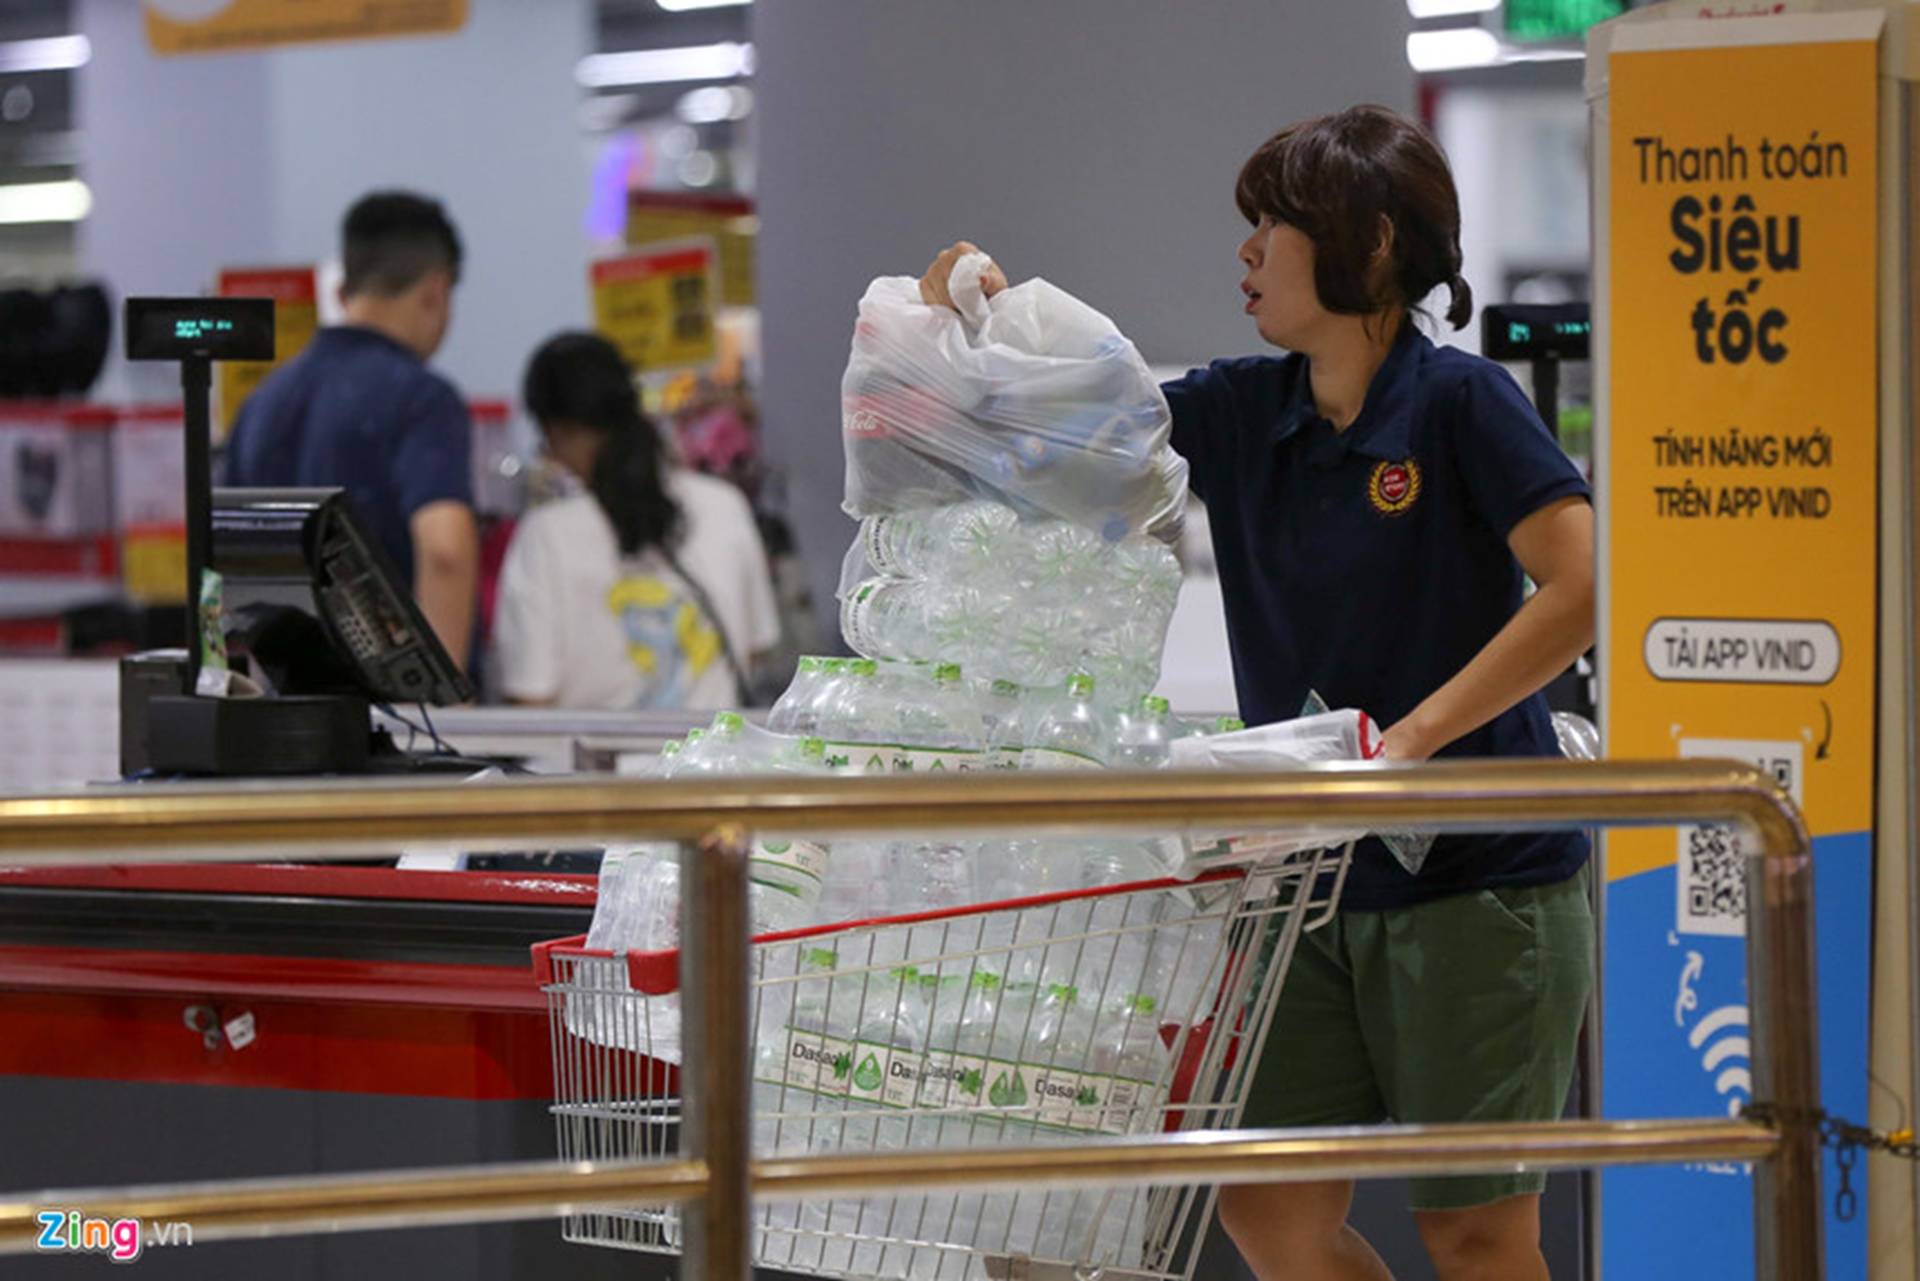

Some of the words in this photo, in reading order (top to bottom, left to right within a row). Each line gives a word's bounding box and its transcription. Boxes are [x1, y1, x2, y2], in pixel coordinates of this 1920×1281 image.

[1633, 134, 1748, 184] Thanh
[1759, 130, 1847, 179] toán
[1669, 194, 1800, 274] Siêu
[1691, 278, 1789, 364] tốc
[1652, 428, 1705, 467] TÍNH
[1708, 428, 1779, 468] NĂNG
[1783, 427, 1832, 468] MỚI
[1653, 478, 1712, 518] TRÊN
[1716, 486, 1763, 519] APP
[1766, 486, 1832, 519] VINID
[1664, 627, 1698, 669] TẢI
[1702, 636, 1750, 670] APP
[1752, 638, 1817, 672] VINID
